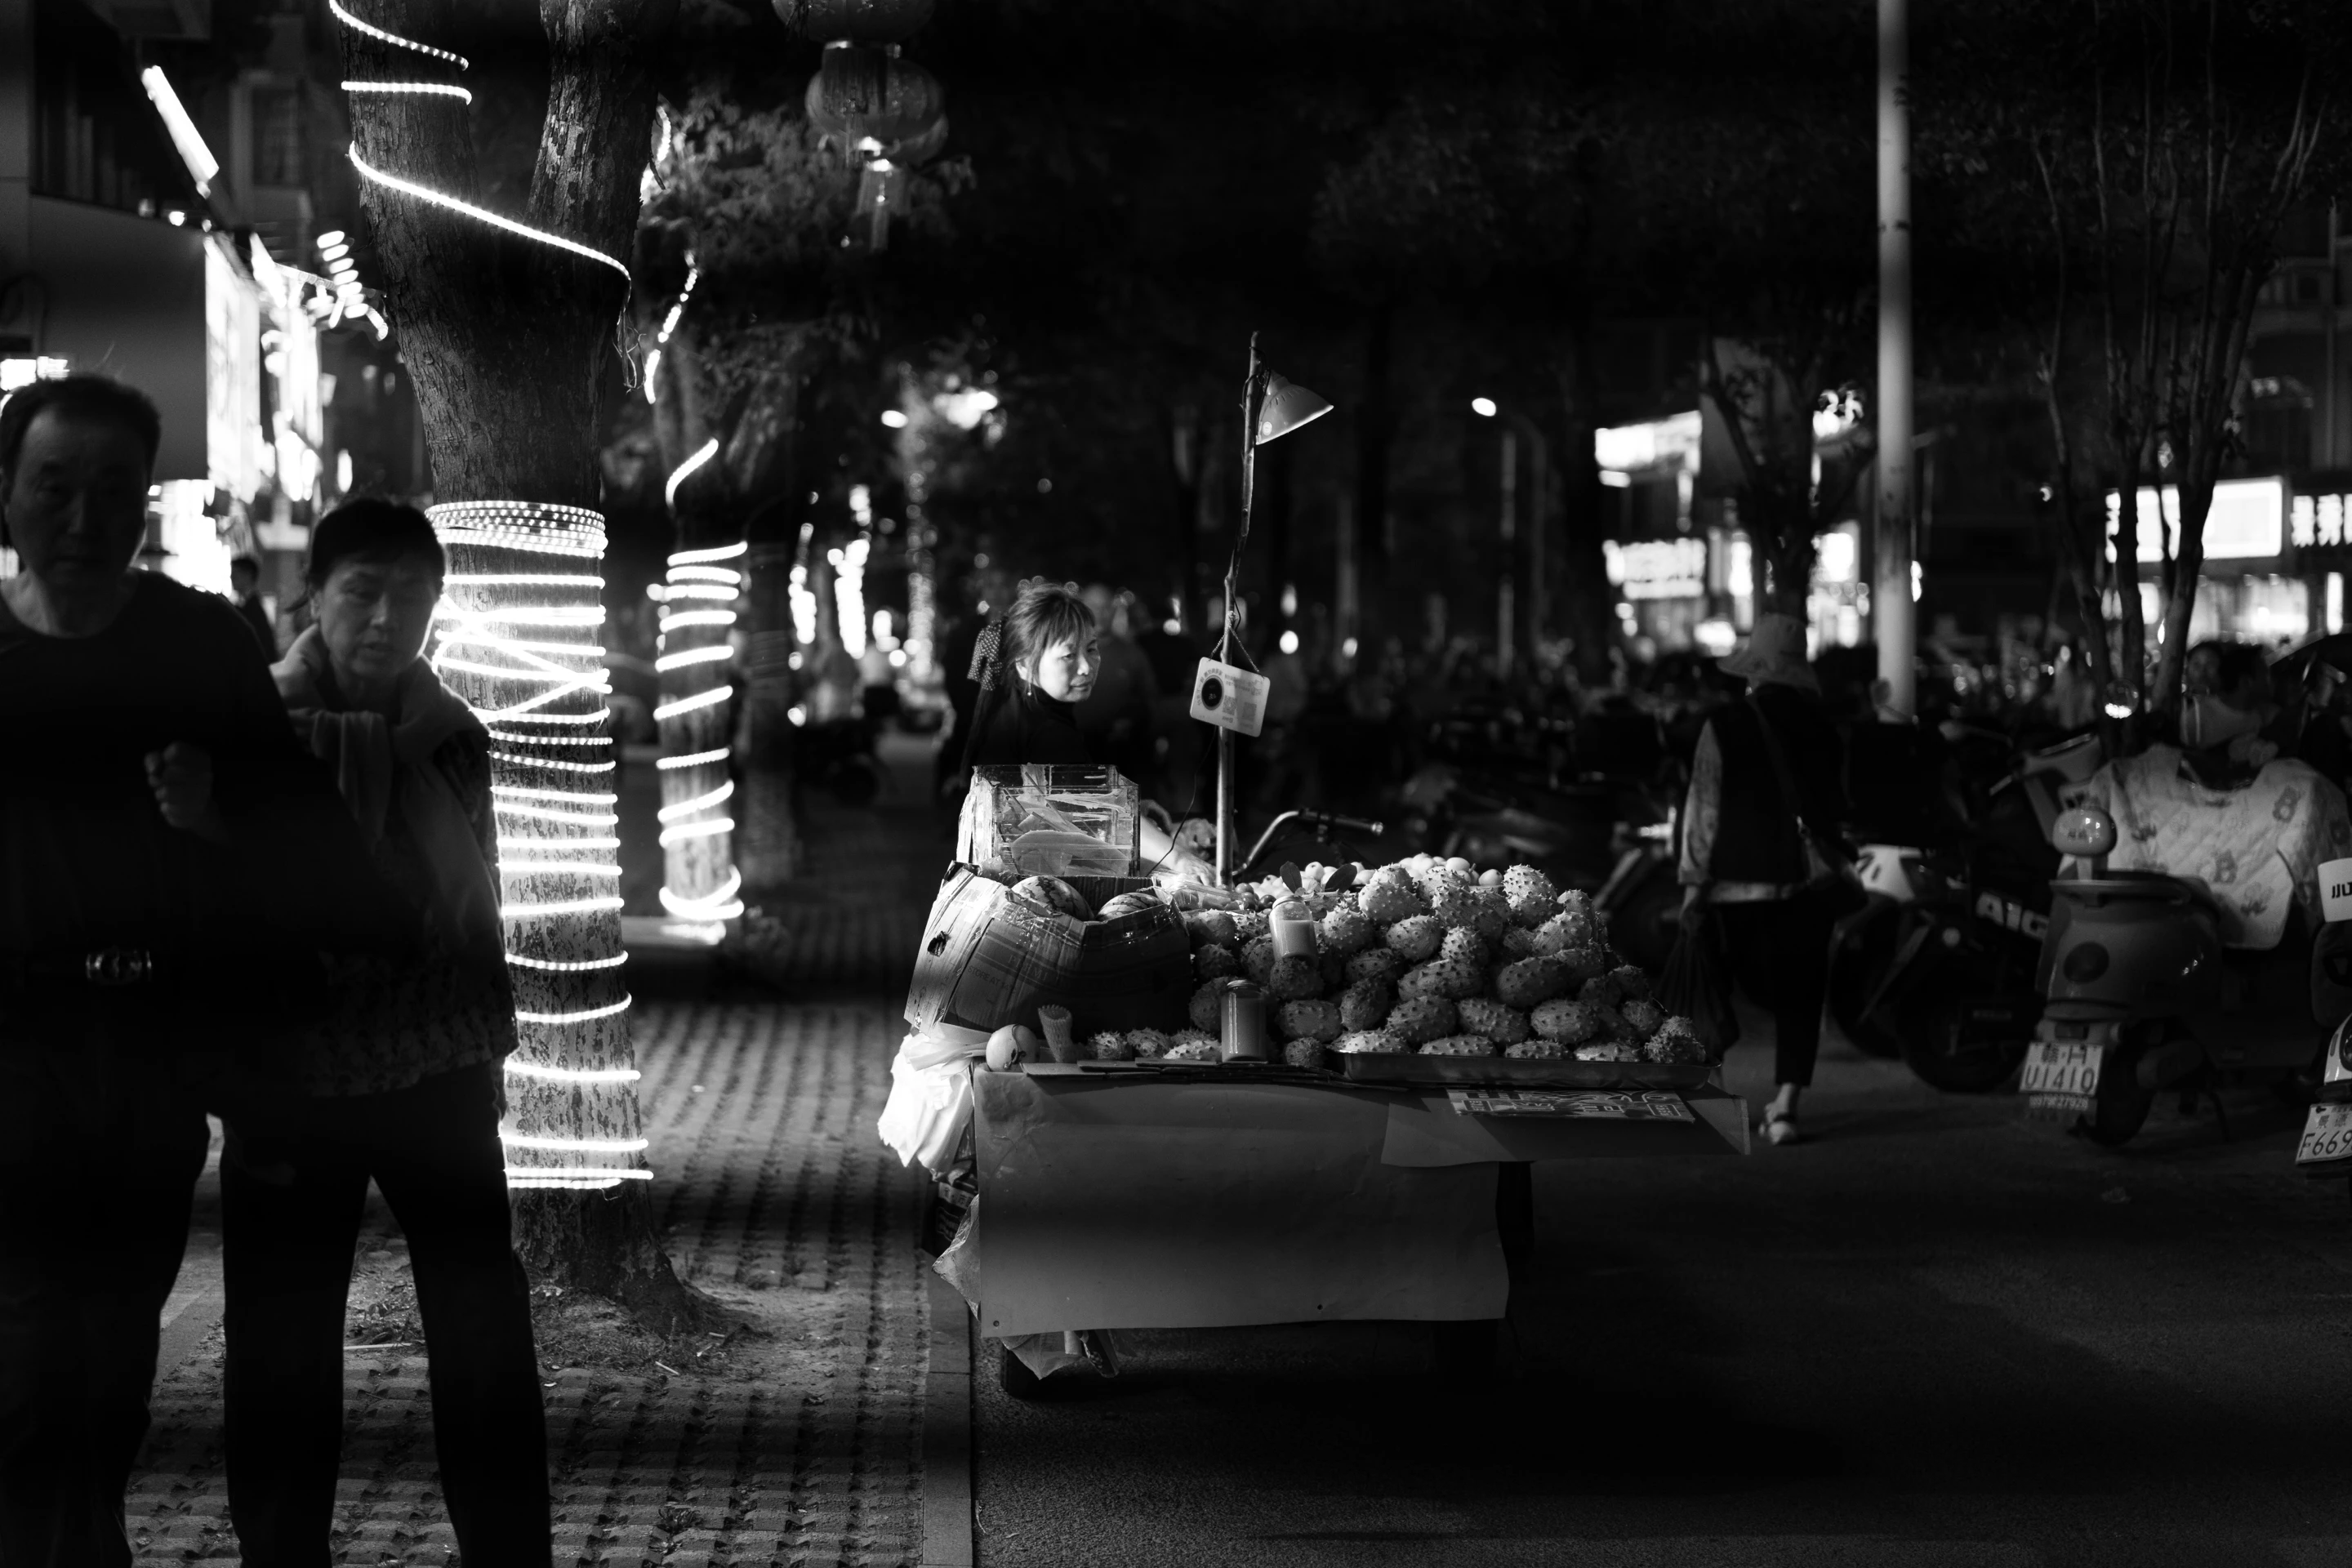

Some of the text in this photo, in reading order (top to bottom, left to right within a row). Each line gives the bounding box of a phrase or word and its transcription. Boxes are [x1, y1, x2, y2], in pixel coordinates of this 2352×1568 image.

[968, 965, 990, 982] STORE
[989, 976, 1000, 987] AT
[2299, 1130, 2352, 1157] F669
